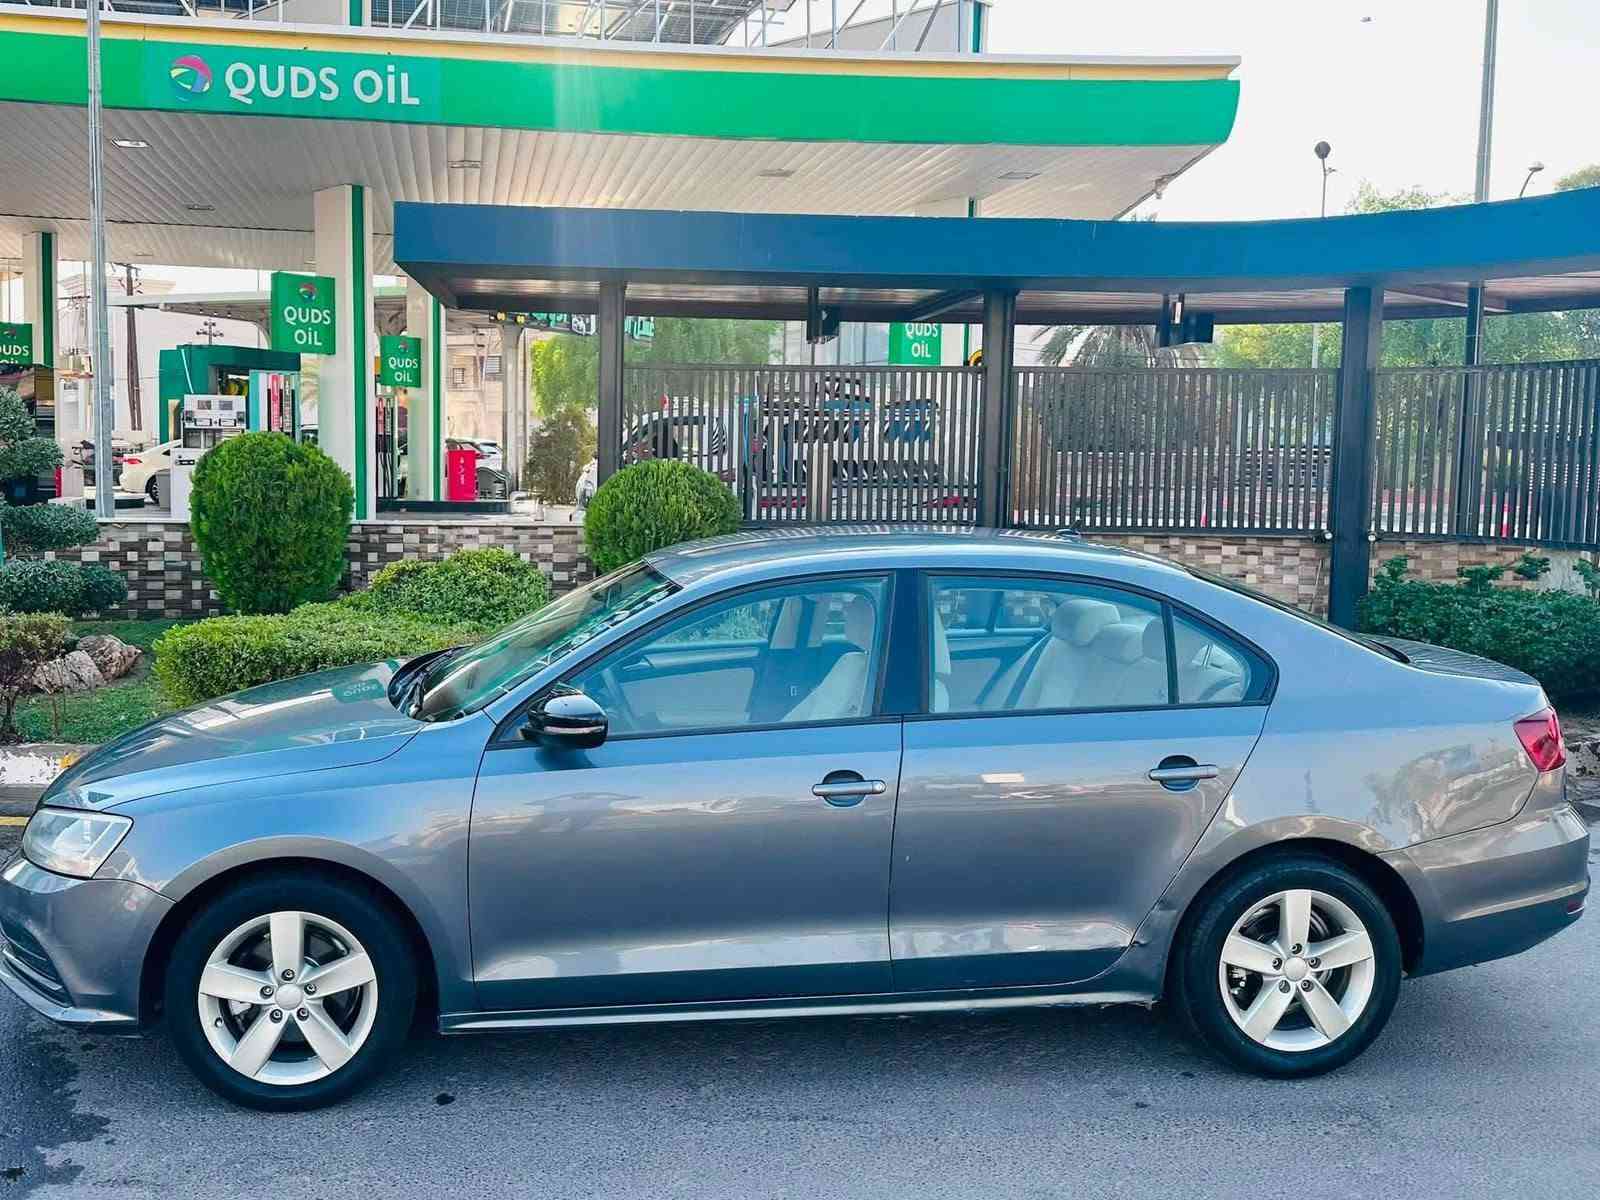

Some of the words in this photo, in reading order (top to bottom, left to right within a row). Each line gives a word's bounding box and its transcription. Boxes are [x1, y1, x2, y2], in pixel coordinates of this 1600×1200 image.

[224, 62, 340, 105] QUDS
[283, 305, 332, 326] QUDS
[904, 322, 938, 340] QUDS
[0, 344, 30, 356] UDS
[388, 356, 418, 370] QUDS
